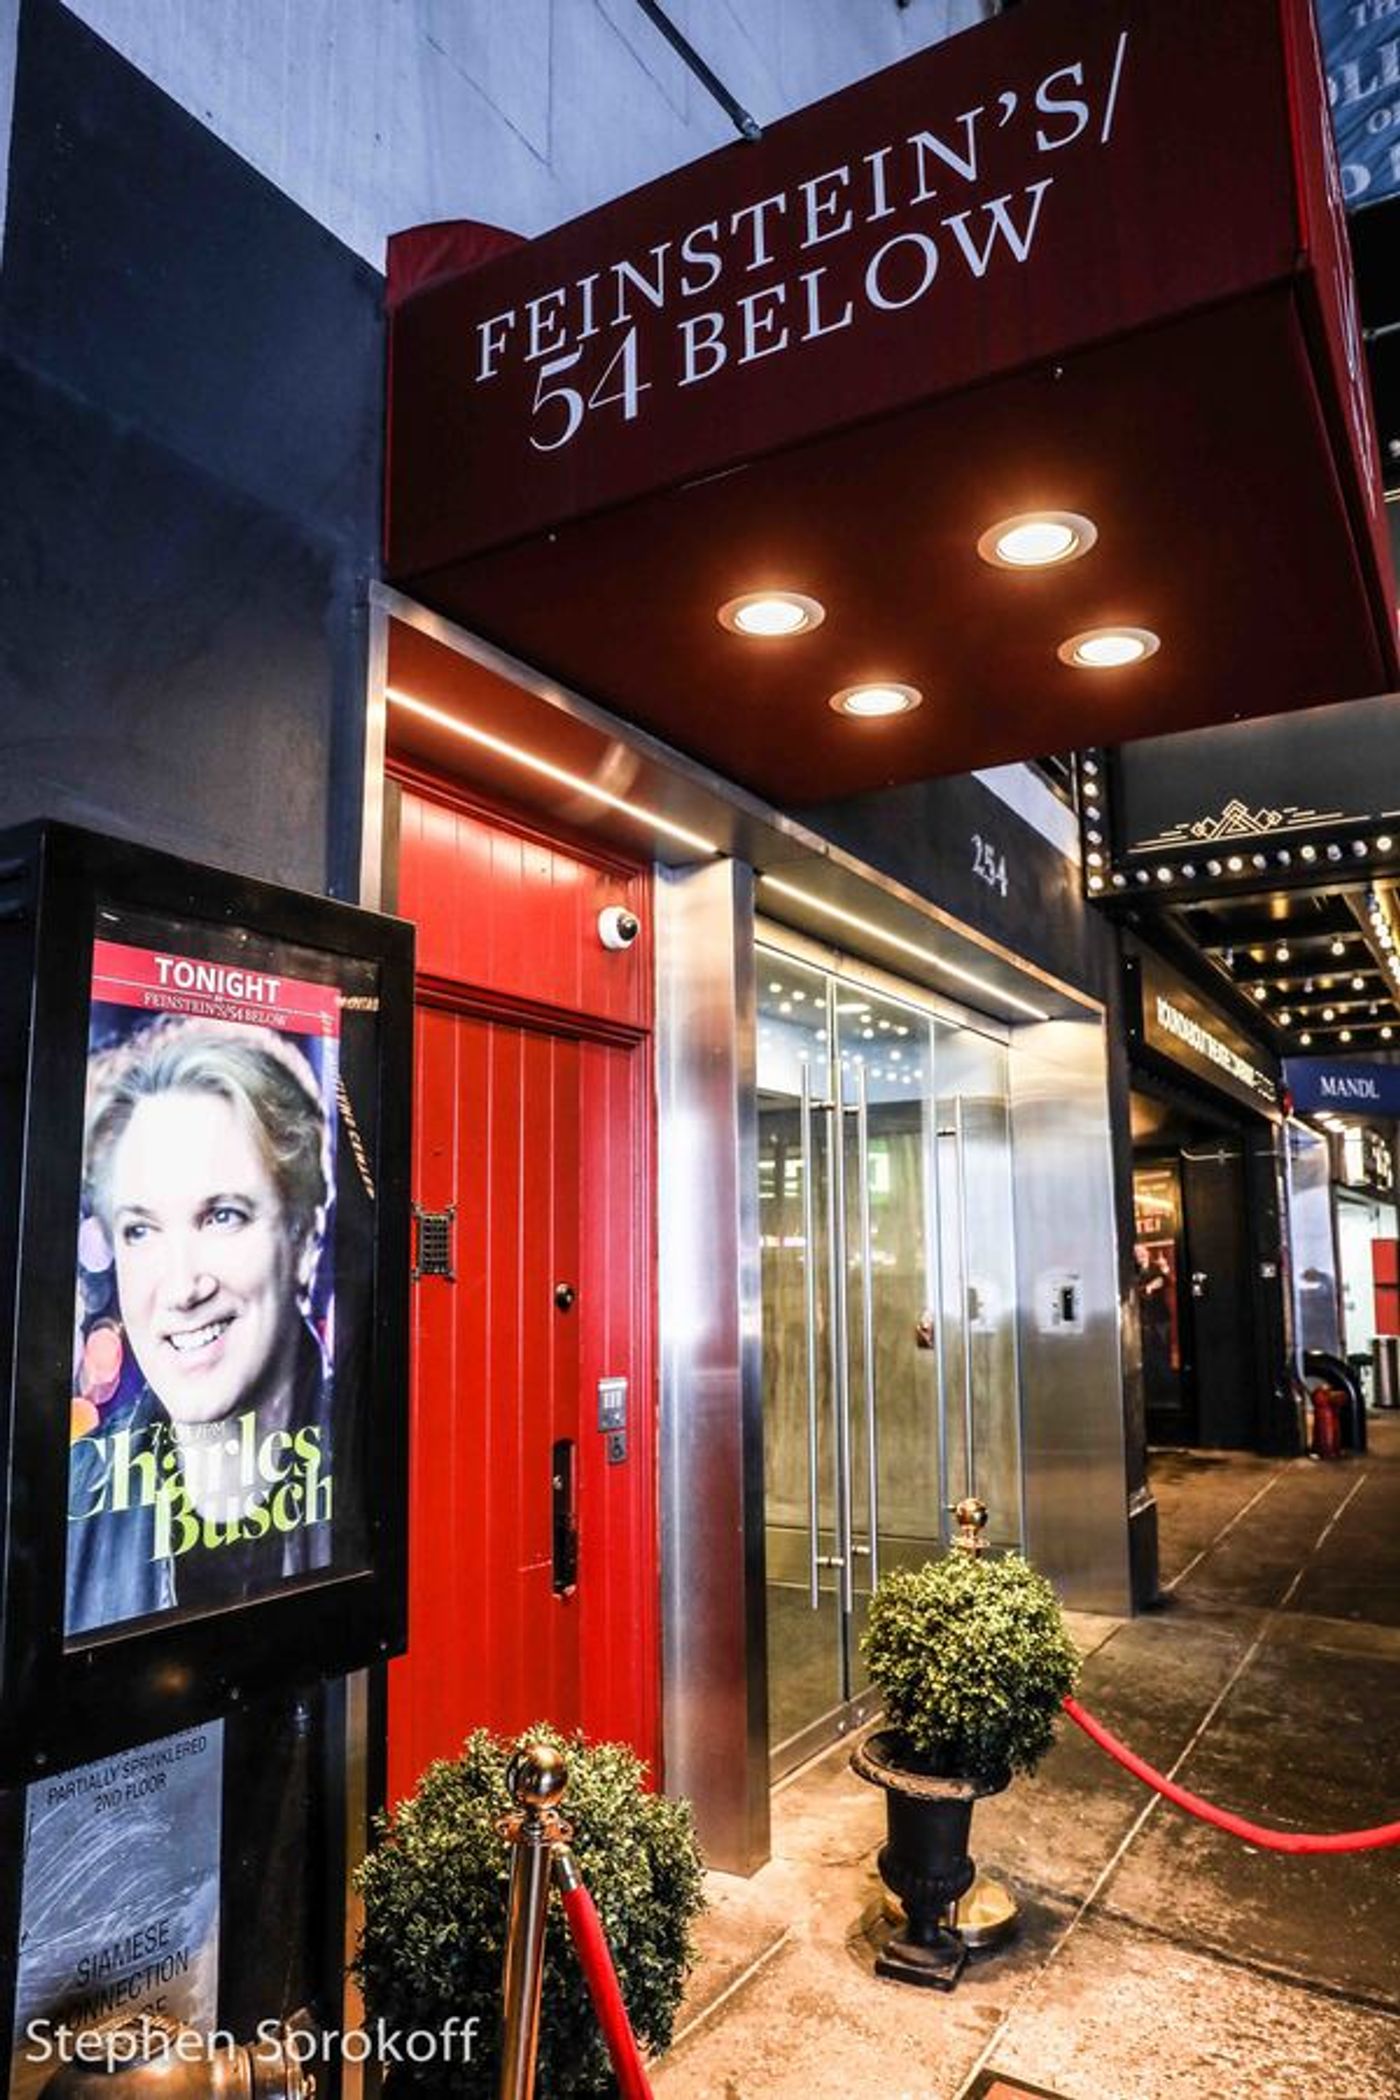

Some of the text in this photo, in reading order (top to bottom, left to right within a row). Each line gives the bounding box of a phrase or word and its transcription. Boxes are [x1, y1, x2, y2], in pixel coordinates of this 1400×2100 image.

[474, 31, 1128, 382] FEINSTEIN'S/
[529, 178, 1055, 451] 54 BELOW
[970, 833, 1008, 897] 254
[154, 956, 282, 1004] TONIGHT
[245, 1008, 287, 1026] BELOW
[1320, 1075, 1380, 1099] MANDL
[67, 1410, 321, 1521] Charles
[150, 1464, 333, 1562] Busch
[47, 1735, 207, 1805] PARTIALLY SPRINKLERED
[94, 1772, 168, 1814] 2ND FLOOR
[76, 1918, 170, 1987] SIAMESE
